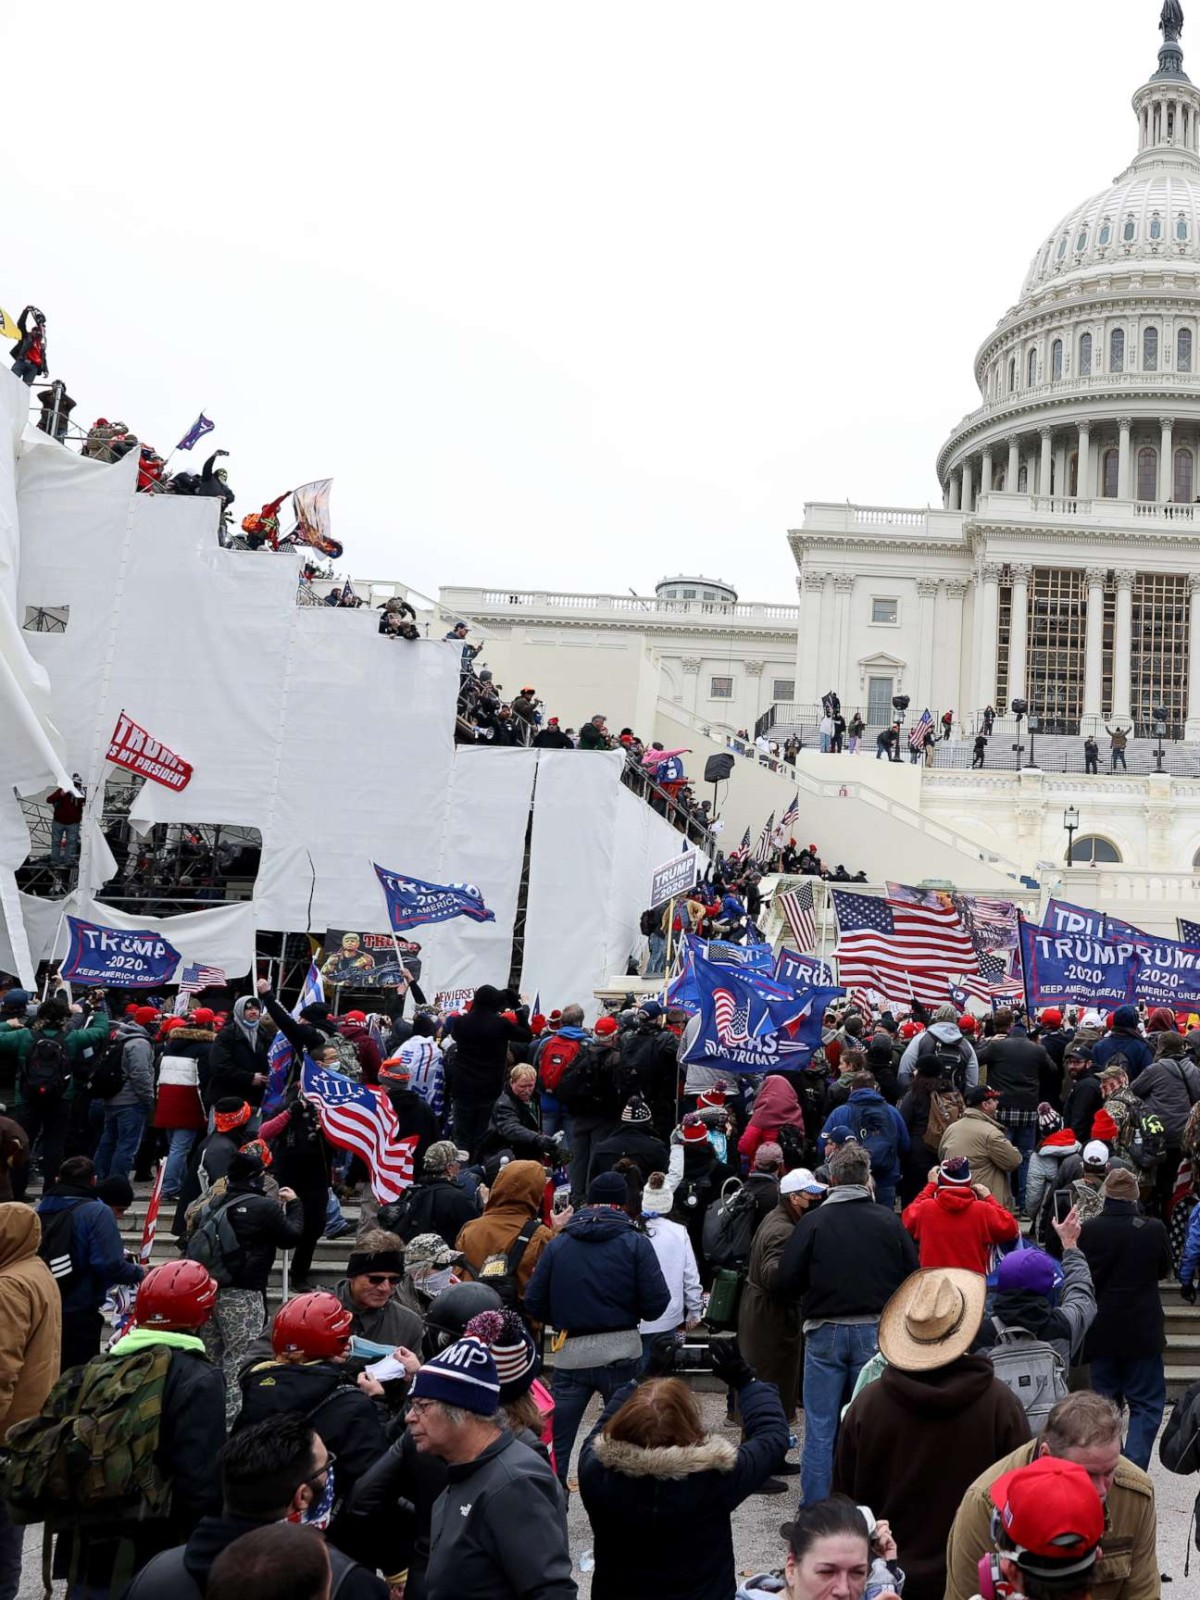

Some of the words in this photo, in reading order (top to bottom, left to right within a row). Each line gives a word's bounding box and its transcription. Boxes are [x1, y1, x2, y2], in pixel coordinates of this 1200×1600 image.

[118, 748, 137, 763] MY
[135, 756, 186, 787] PRESIDENT
[655, 859, 694, 887] TRUMP
[83, 930, 166, 958] TRUMP
[1036, 936, 1134, 966] TRUMP
[75, 967, 100, 976] KEEP
[101, 970, 135, 980] AMERICA
[1040, 985, 1063, 994] KEEP
[1064, 985, 1096, 997] AMERICA
[1096, 989, 1126, 999] GREAT!
[1135, 985, 1175, 998] AMERICA
[731, 1051, 781, 1065] TRUMP
